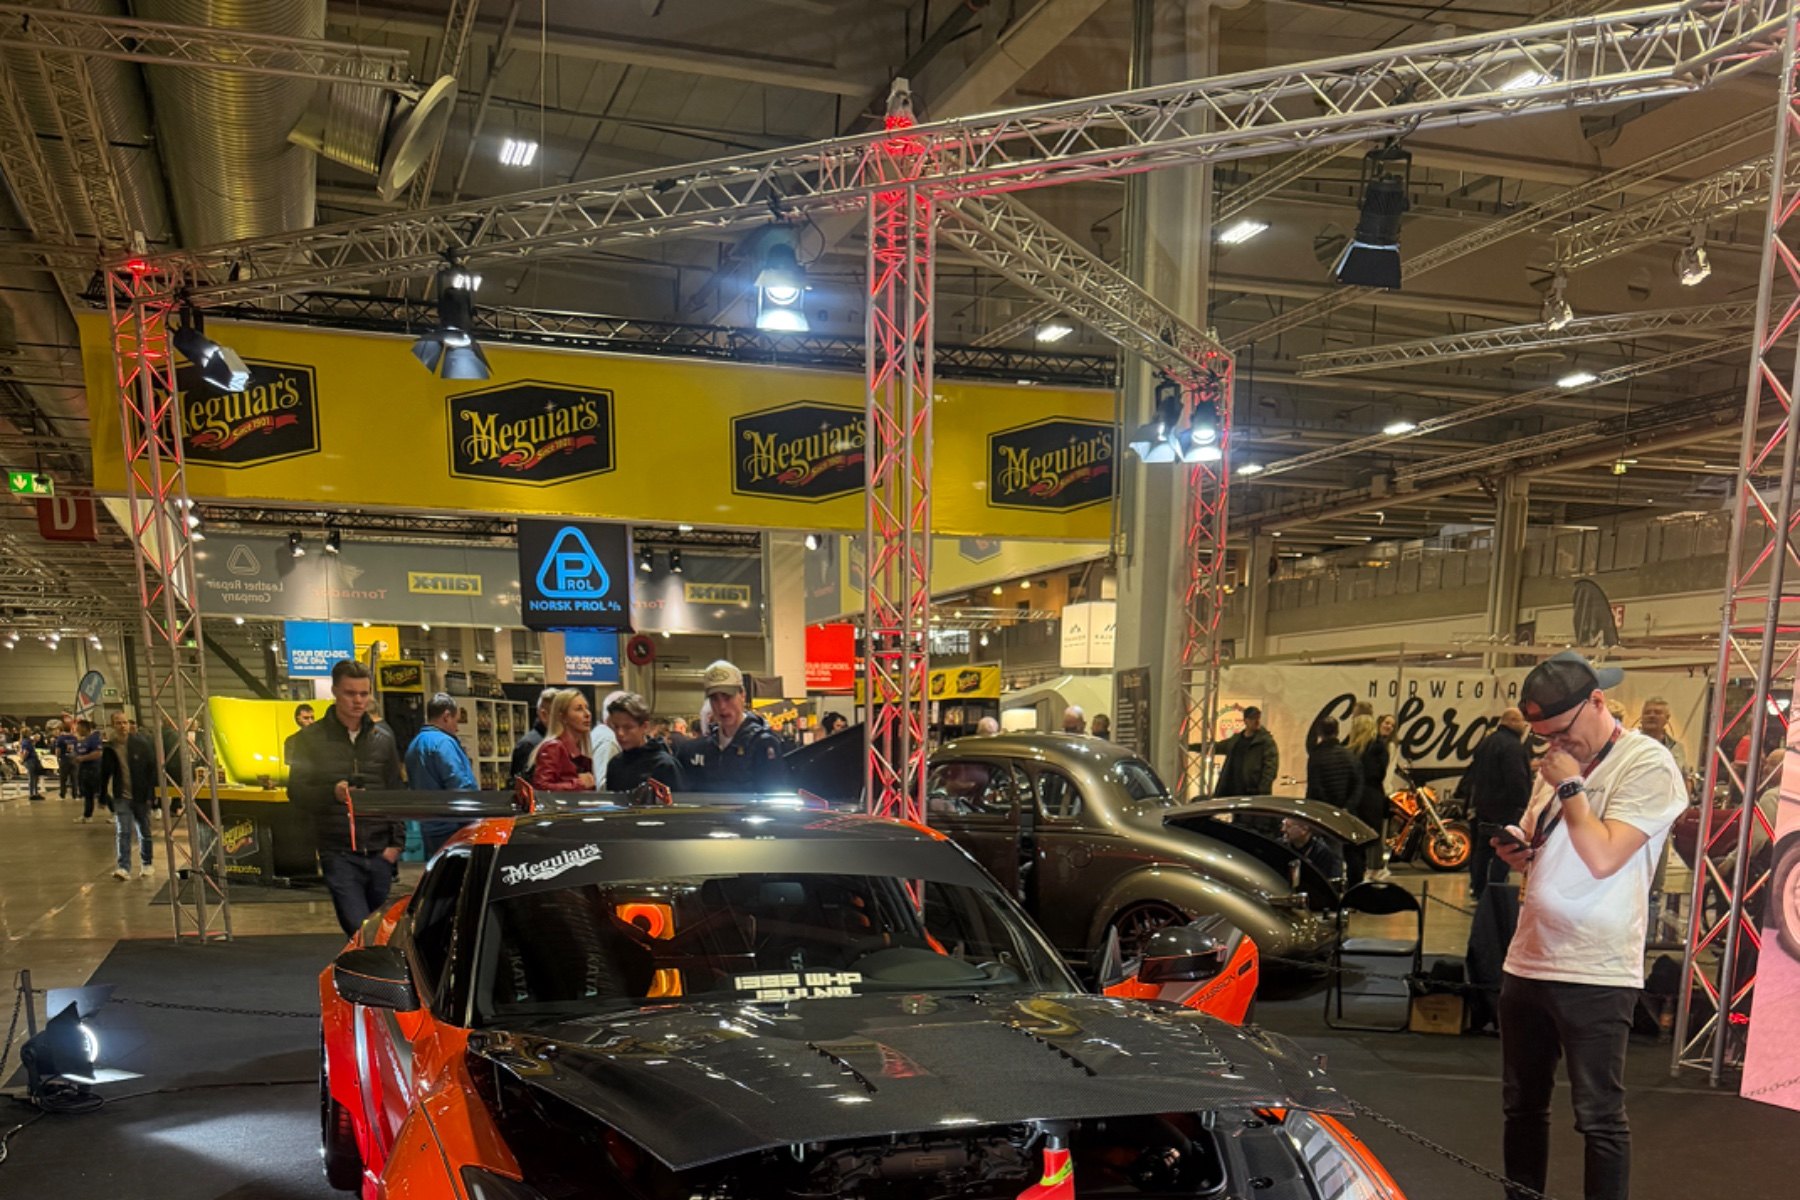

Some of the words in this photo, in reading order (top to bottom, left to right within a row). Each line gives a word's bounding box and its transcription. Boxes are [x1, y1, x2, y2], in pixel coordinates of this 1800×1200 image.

[460, 396, 599, 469] Meguiar's
[742, 416, 867, 487] Meguiar's
[997, 430, 1112, 497] Meguiar's
[52, 496, 77, 530] D
[529, 600, 572, 611] NORSK
[574, 600, 607, 611] PROL
[1369, 680, 1517, 699] NORWEGIA
[500, 843, 602, 886] Meguiar's
